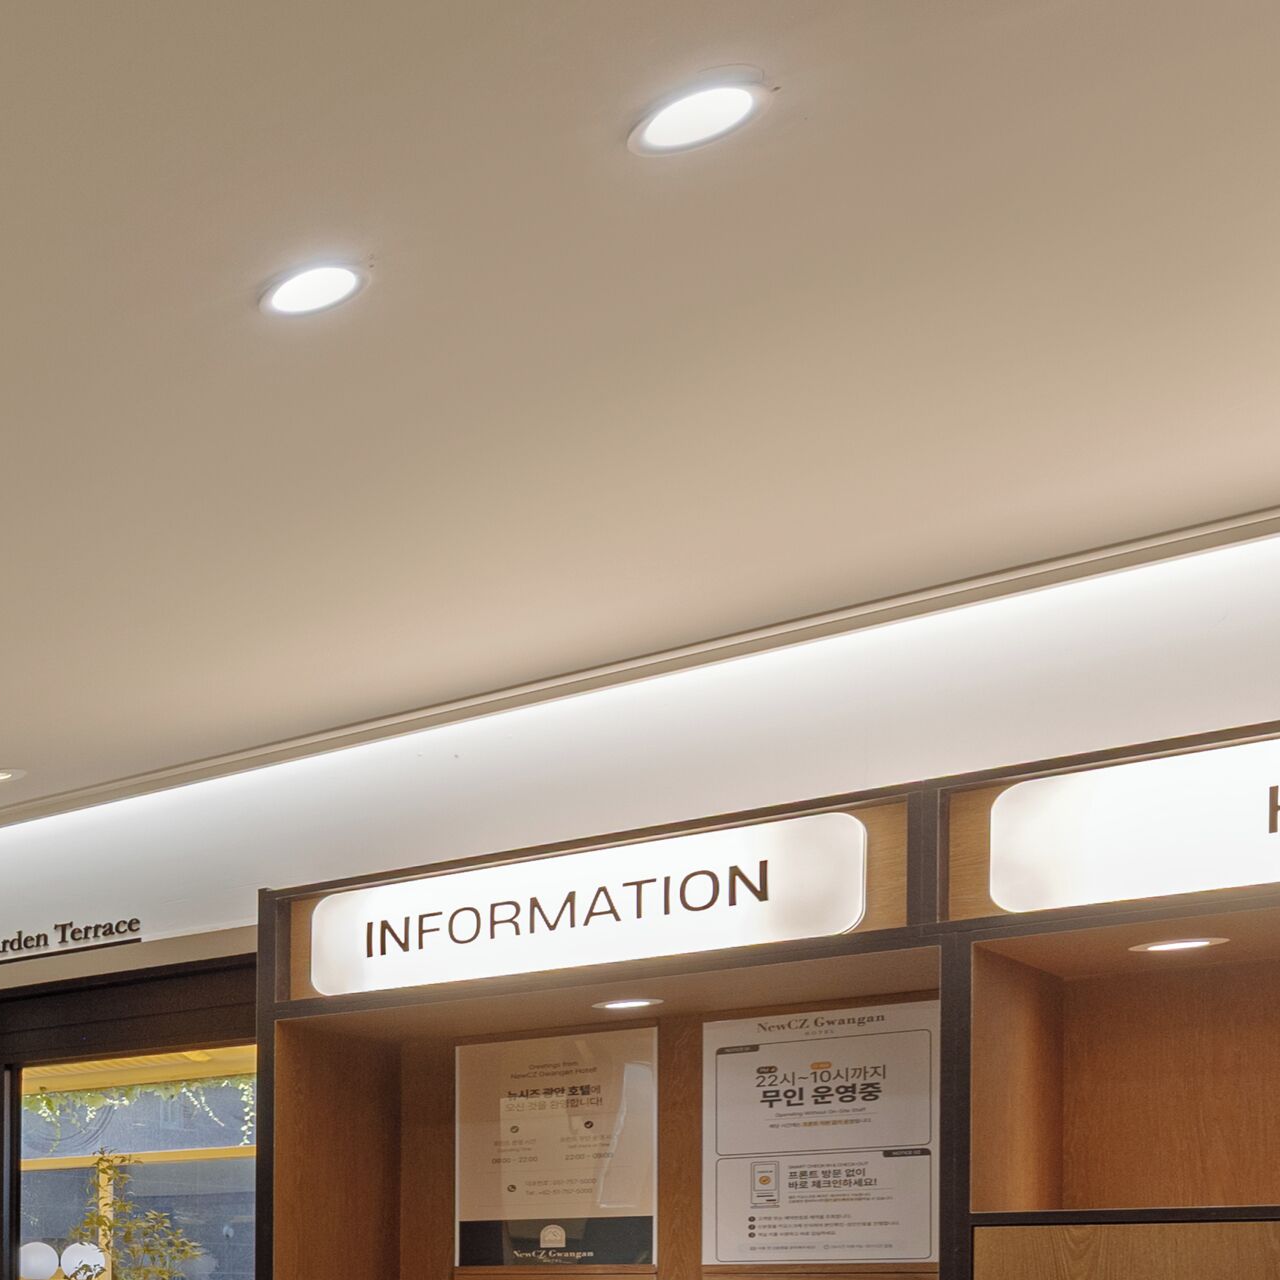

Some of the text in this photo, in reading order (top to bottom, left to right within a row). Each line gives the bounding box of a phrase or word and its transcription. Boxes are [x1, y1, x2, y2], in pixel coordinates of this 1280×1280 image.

[366, 859, 769, 958] INFORMATION
[53, 917, 141, 944] Terrace
[757, 1014, 885, 1033] NewCZ Gwangan
[755, 1065, 887, 1088] 22시~10시까지
[507, 1084, 601, 1101] 뉴시즈 광안 호텔에
[760, 1082, 883, 1108] 무인 운영중
[788, 1167, 866, 1180] 프론트 방문 없이
[788, 1178, 878, 1190] 바로 체크인하세요!
[512, 1250, 594, 1260] NewCZ Gwangan
